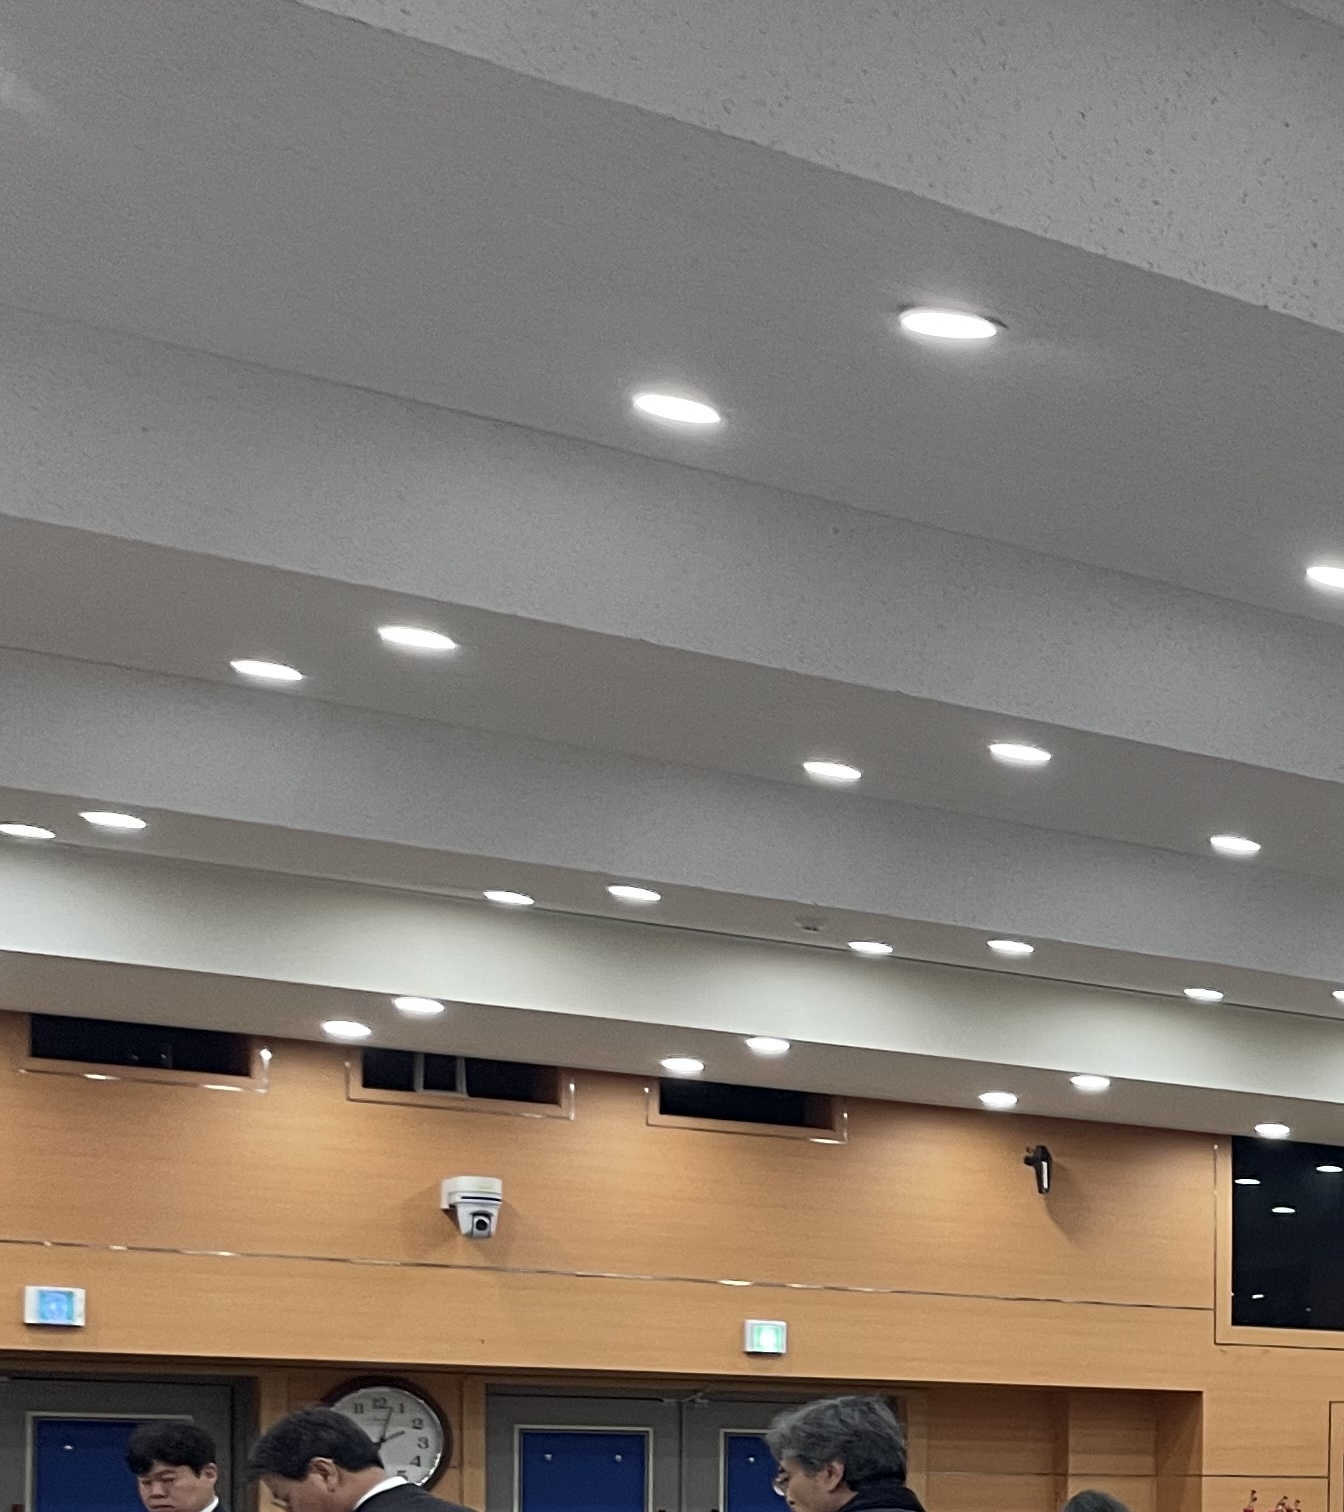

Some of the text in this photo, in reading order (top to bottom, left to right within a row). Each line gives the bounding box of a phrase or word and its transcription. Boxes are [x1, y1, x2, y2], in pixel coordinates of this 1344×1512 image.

[372, 1397, 387, 1410] 12
[400, 1403, 405, 1414] 1
[412, 1418, 424, 1430] 2
[417, 1436, 429, 1450] 3
[409, 1455, 421, 1467] 4
